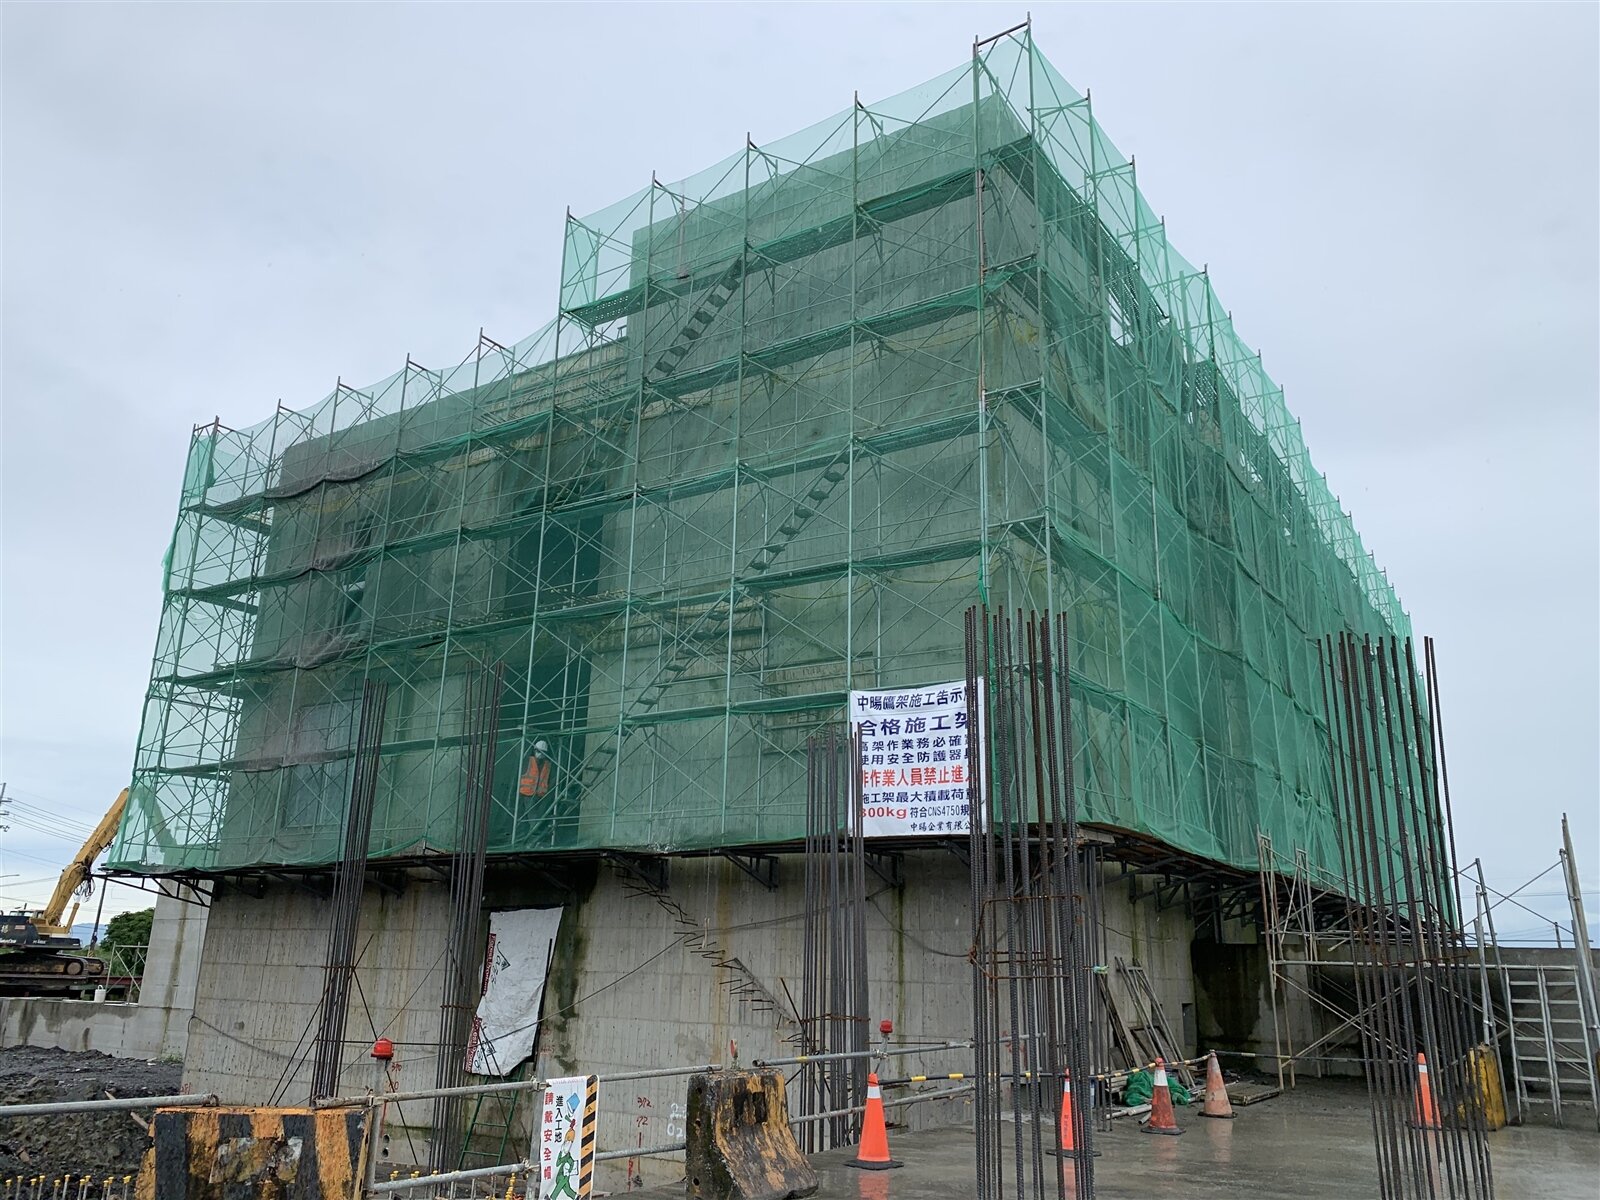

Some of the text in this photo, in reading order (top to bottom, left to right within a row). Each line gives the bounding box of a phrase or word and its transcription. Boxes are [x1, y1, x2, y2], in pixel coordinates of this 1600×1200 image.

[857, 686, 967, 712] 中暘鷹架施工告示
[860, 711, 968, 737] 合格施工架
[862, 734, 968, 752] 高架作業務必確
[862, 748, 968, 766] 使用安全防護器
[554, 1095, 564, 1143] 進入工地
[543, 1091, 554, 1180] 請戴安全帽
